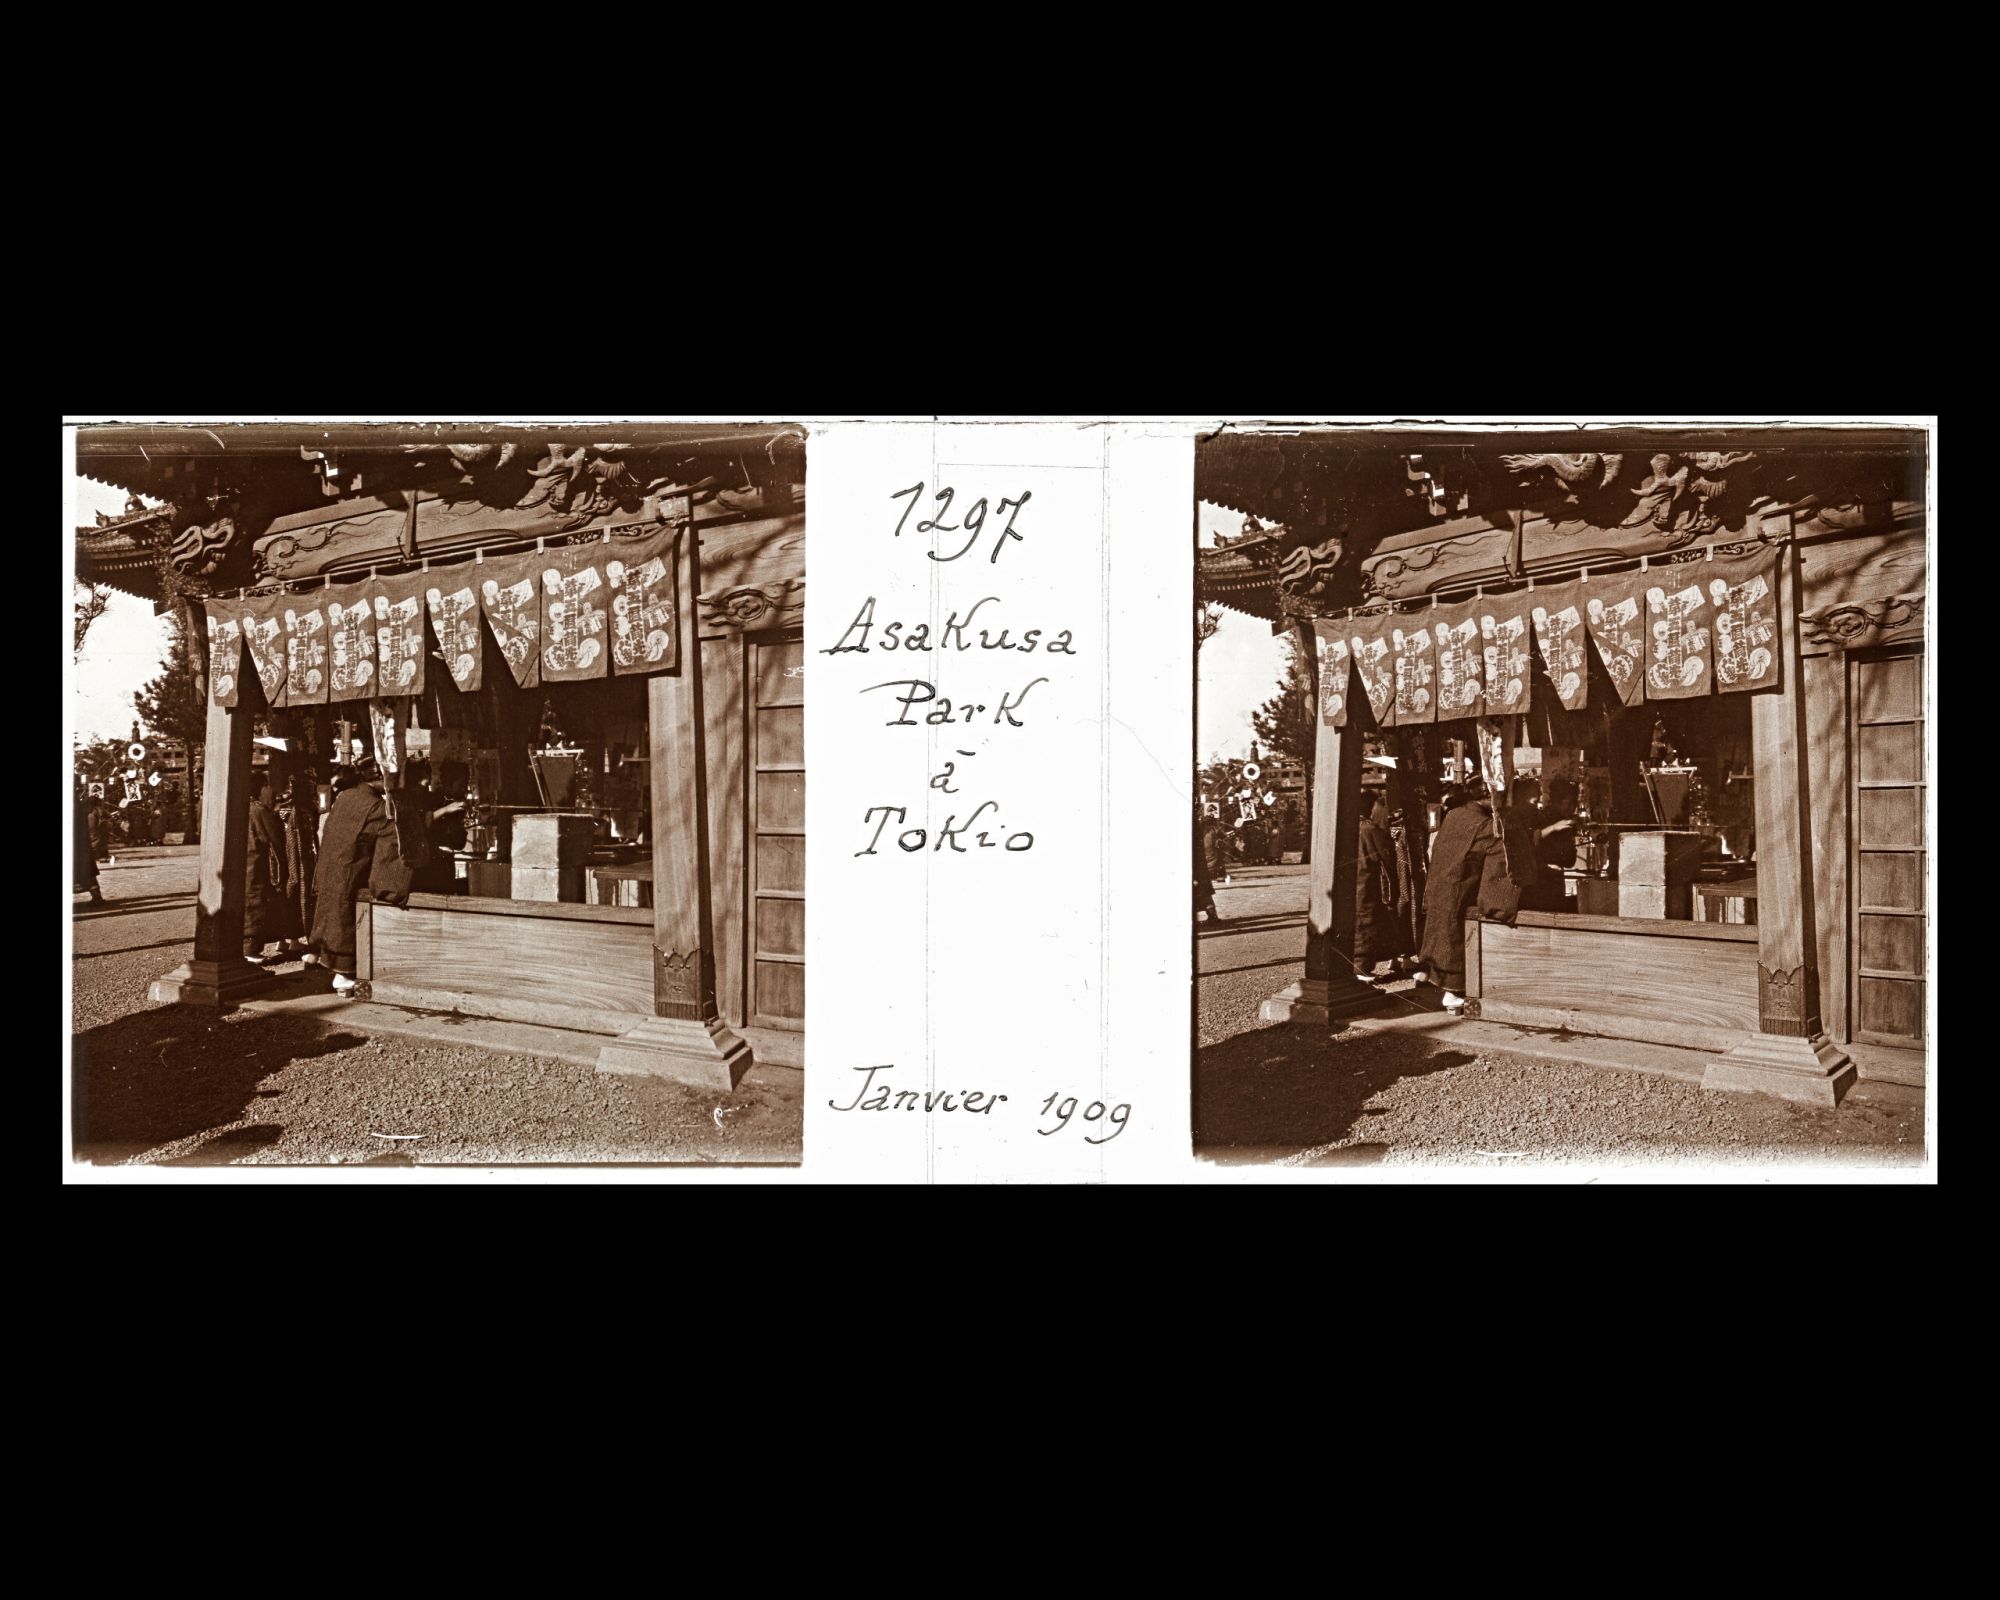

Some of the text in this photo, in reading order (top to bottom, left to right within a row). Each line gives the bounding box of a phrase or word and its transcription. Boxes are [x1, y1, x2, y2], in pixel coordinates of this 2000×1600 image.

[891, 481, 1032, 563] 1297
[828, 1064, 1132, 1145] Janvier 1909
